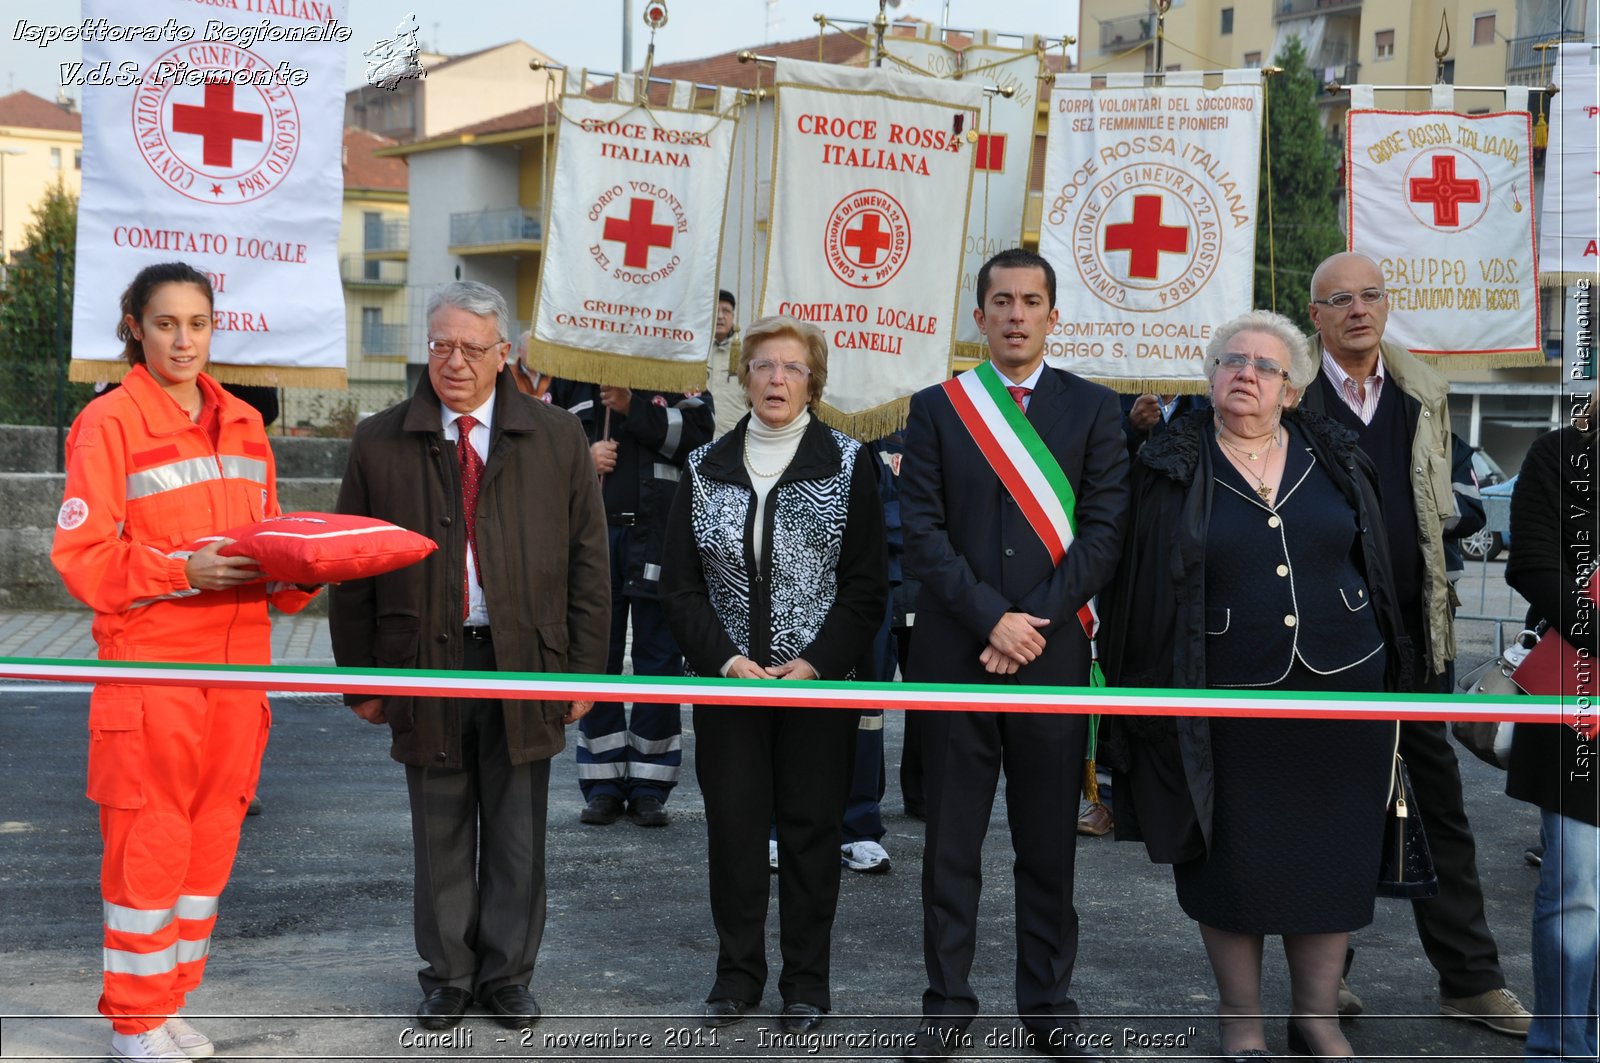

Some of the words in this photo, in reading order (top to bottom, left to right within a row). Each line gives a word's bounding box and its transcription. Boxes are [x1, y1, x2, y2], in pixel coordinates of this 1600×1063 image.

[1100, 97, 1161, 113] VOLONTARI
[1168, 98, 1190, 111] DEL
[1196, 97, 1254, 112] SOCCORSO
[580, 118, 647, 140] CROCE
[652, 127, 712, 148] ROSSA
[797, 113, 877, 141] CROCE
[888, 123, 960, 153] ROSSA
[1099, 116, 1164, 131] FEMMINILE
[1167, 116, 1175, 131] E
[1179, 116, 1228, 131] PIONIERI
[267, 108, 296, 175] AGOSTO
[600, 142, 691, 168] ITALIANA
[1367, 130, 1407, 164] CROCE
[1408, 122, 1452, 149] ROSSA
[1456, 125, 1520, 168] ITALIANA
[822, 143, 931, 177] ITALIANA
[237, 170, 271, 198] 1864
[1048, 158, 1099, 226] CROCE
[1099, 135, 1176, 165] ROSSA
[1181, 142, 1249, 229] ITALIANA
[1100, 181, 1118, 199] DI
[1123, 167, 1194, 197] GINEVRA
[588, 184, 624, 222] CORPO
[628, 181, 689, 234] VOLONTARI
[841, 203, 853, 216] DI
[853, 195, 892, 213] GINEVRA
[889, 210, 900, 223] 22
[1193, 196, 1212, 217] 22
[113, 225, 228, 254] COMITATO
[236, 236, 308, 264] LOCALE
[589, 243, 611, 272] DEL
[829, 214, 855, 278] CONVENZIONE
[891, 224, 905, 265] AGOSTO
[1078, 201, 1127, 304] CONVENZIONE
[1192, 221, 1217, 279] AGOSTO
[613, 255, 681, 285] SOCCORSO
[1379, 256, 1466, 286] GRUPPO
[1479, 257, 1520, 285] V.D.S.
[1158, 276, 1196, 305] 1864
[1386, 287, 1455, 311] TELNUOVO
[1457, 287, 1482, 311] DON
[1486, 287, 1520, 311] BOSCO
[213, 310, 270, 332] ERRA
[583, 299, 652, 320] GRUPPO
[655, 309, 674, 322] DI
[779, 301, 868, 324] COMITATO
[876, 306, 938, 335] LOCALE
[834, 329, 903, 356] CANELLI
[1052, 322, 1135, 337] COMITATO
[1142, 323, 1212, 340] LOCALE
[1112, 342, 1128, 359] S.
[1136, 343, 1205, 360] DALMA
